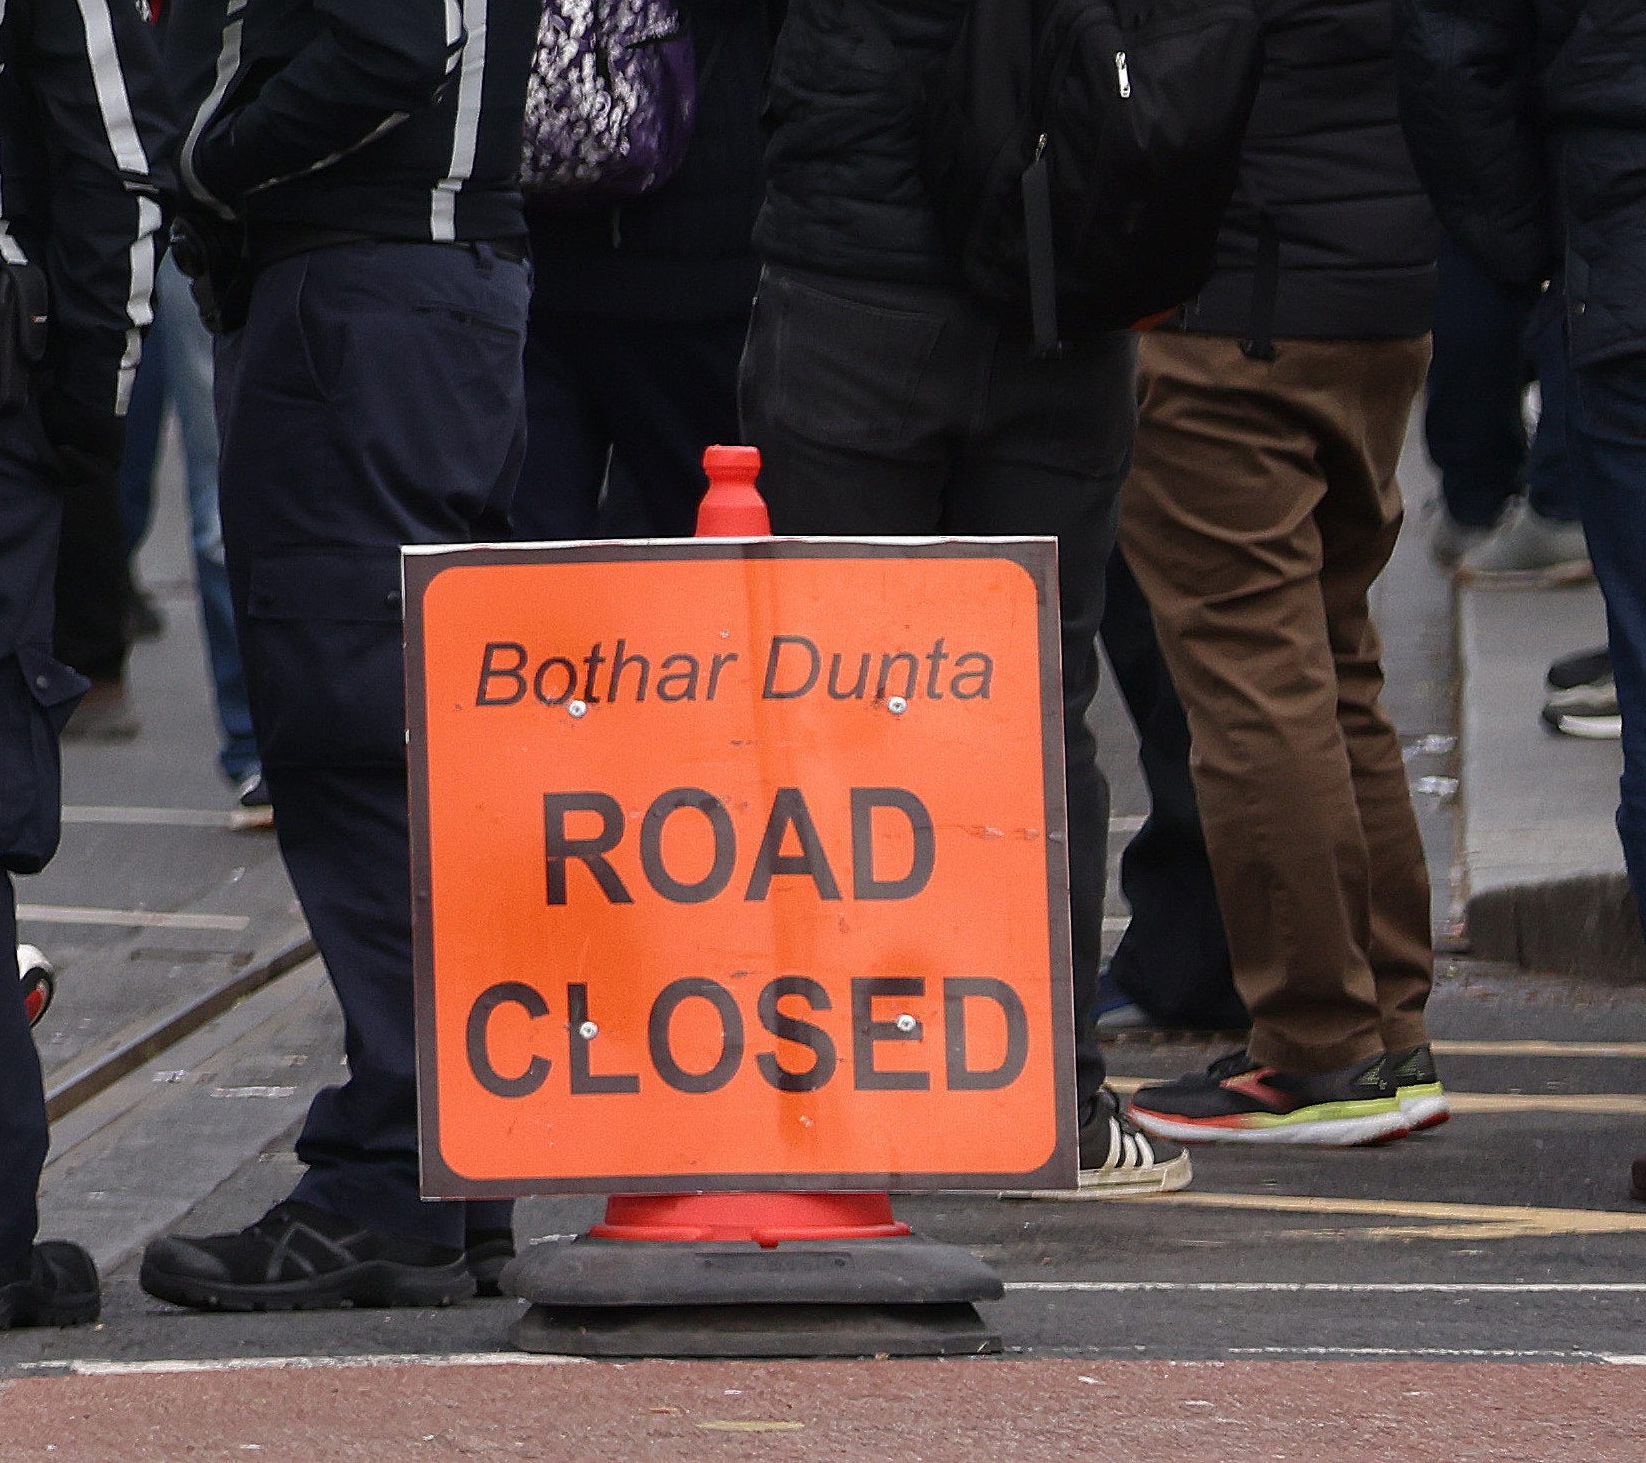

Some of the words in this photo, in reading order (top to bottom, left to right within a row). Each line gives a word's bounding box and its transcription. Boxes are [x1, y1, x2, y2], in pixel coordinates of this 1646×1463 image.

[476, 638, 743, 708] Bothar
[762, 634, 994, 702] Dunta
[543, 787, 937, 906] ROAD
[466, 976, 1029, 1099] CLOSED
